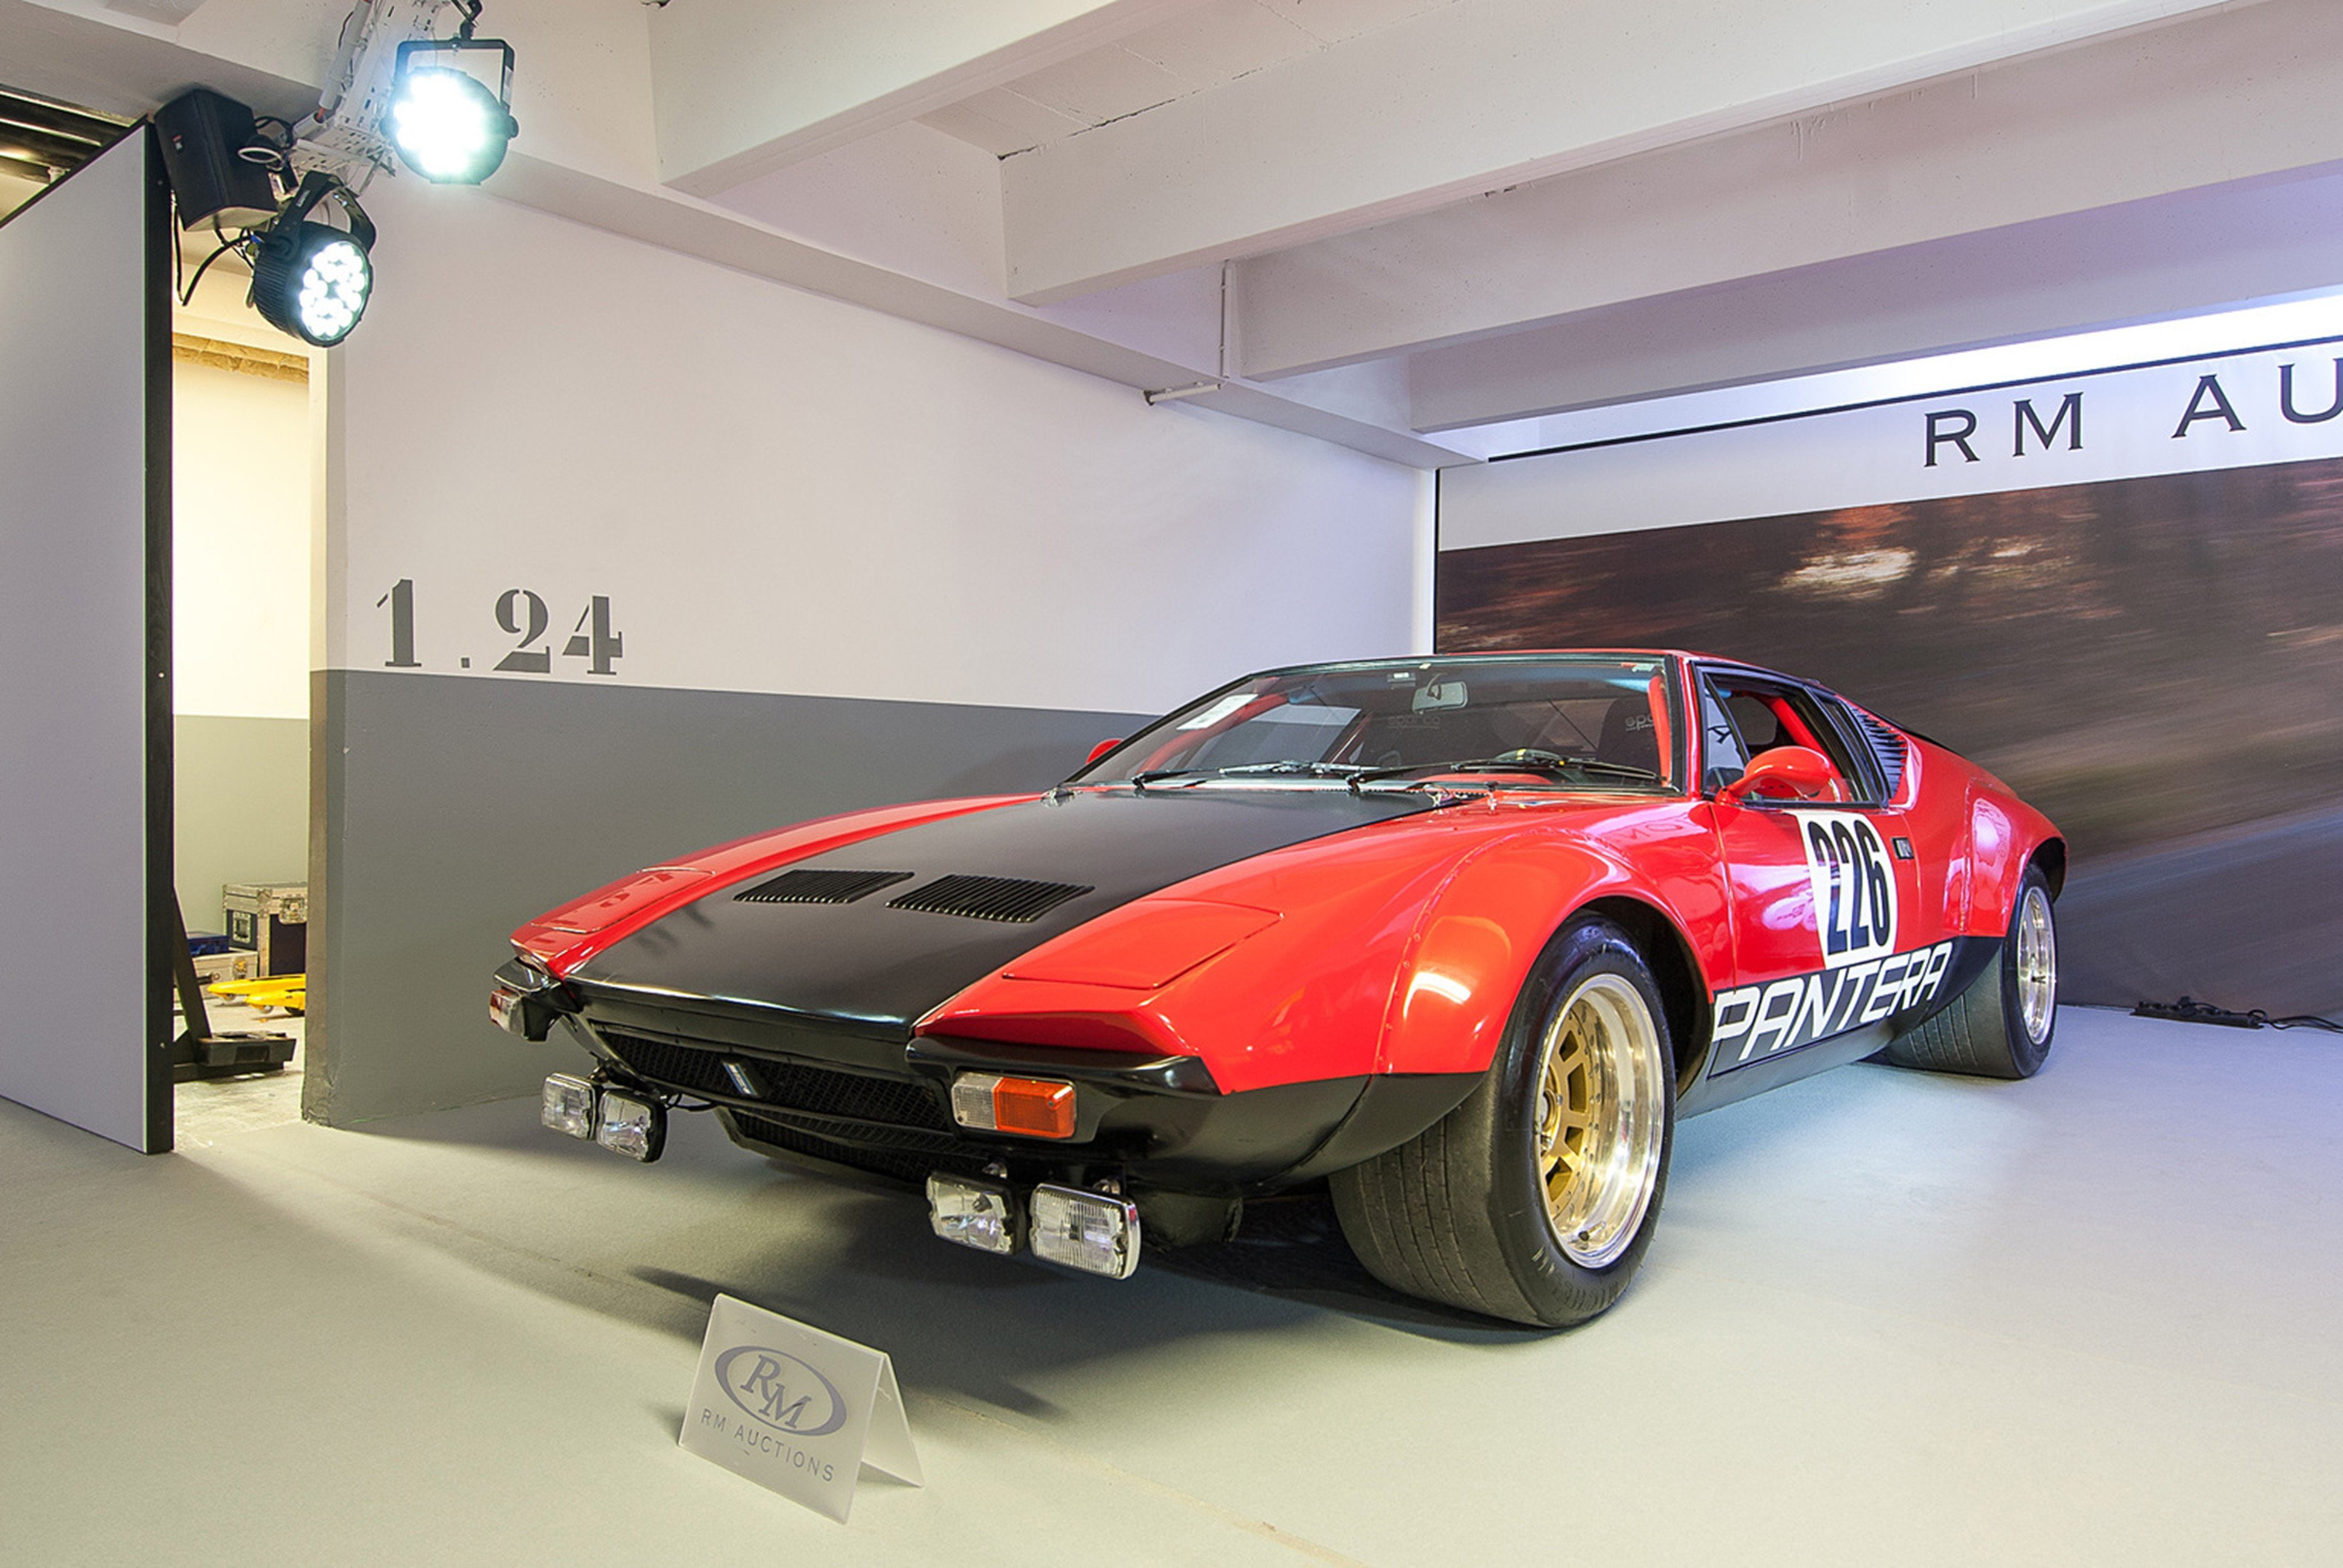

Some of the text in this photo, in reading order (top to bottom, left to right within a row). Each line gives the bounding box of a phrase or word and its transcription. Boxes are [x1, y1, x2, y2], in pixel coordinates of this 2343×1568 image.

[1924, 392, 2084, 467] RM
[1808, 820, 1891, 955] 226
[1712, 942, 1953, 1061] PANTERA
[740, 1354, 812, 1429] RM
[701, 1408, 834, 1482] RM AUCTIONS
